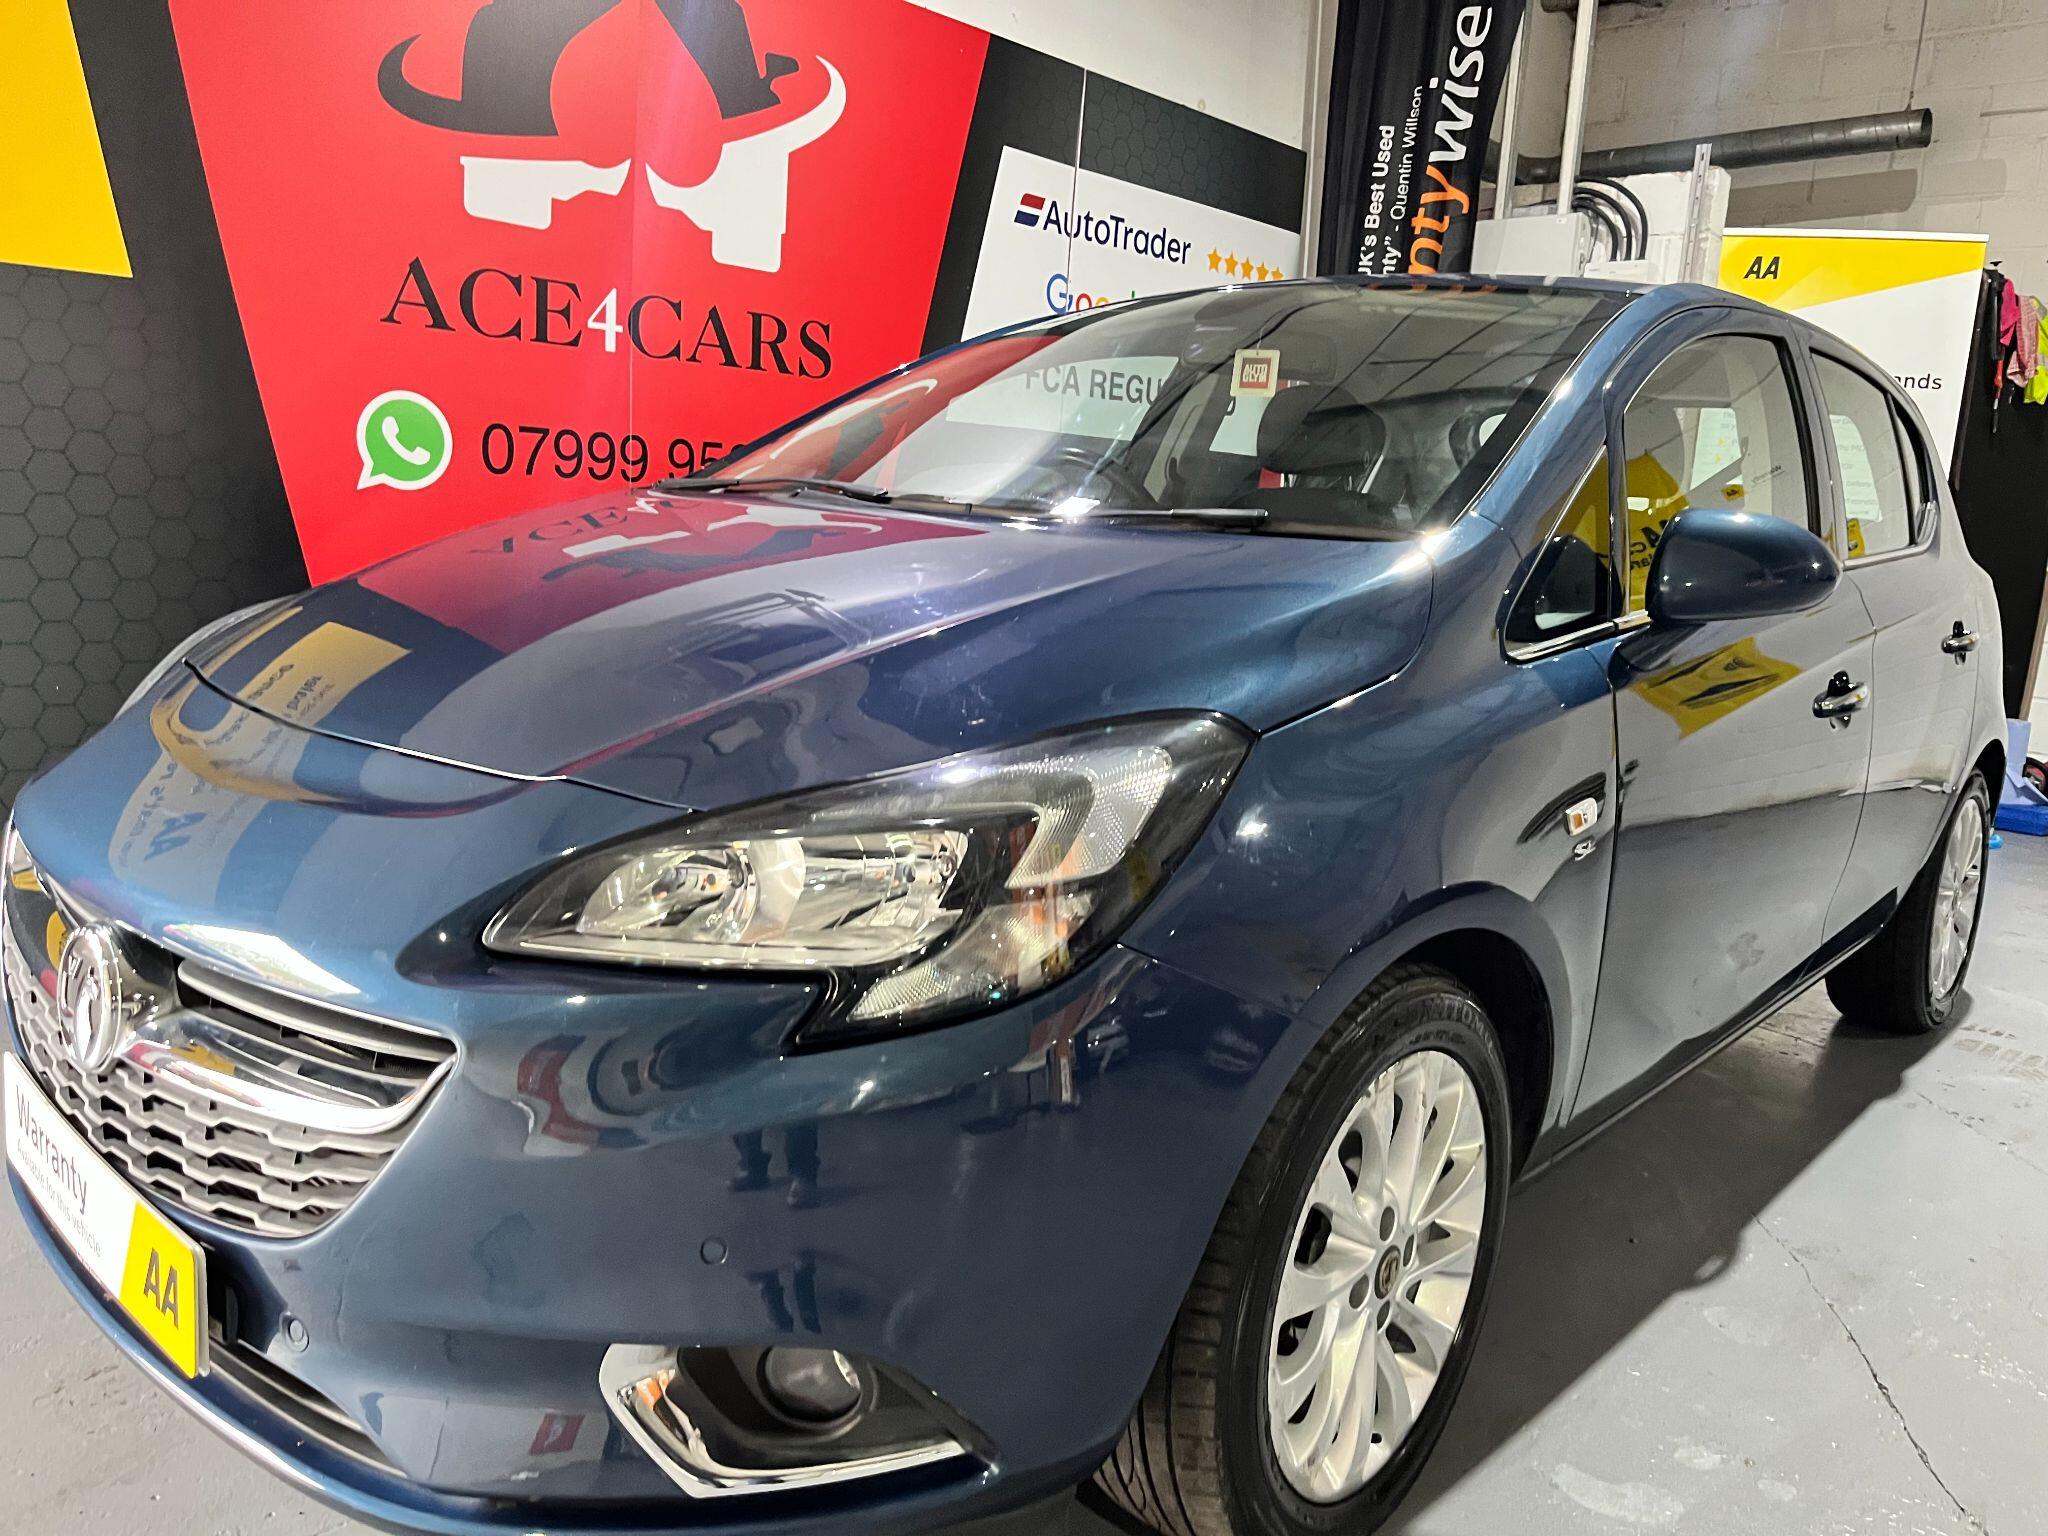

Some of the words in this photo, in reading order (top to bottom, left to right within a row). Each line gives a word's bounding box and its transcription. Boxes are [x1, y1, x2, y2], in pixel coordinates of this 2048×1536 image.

[1372, 125, 1395, 177] Used
[1390, 153, 1413, 219] Quentin
[1402, 85, 1423, 148] Willson
[1408, 5, 1493, 274] ntywise
[1042, 200, 1192, 265] AutoTrader
[1364, 182, 1386, 229] Best
[1743, 255, 1781, 280] AA
[380, 256, 833, 381] ACE4CARS
[1025, 365, 1081, 397] FCA
[1089, 369, 1163, 406] REGU
[481, 422, 649, 483] 07999
[667, 438, 745, 479] 95
[15, 1084, 88, 1215] Warranty
[72, 1213, 102, 1258] vehicle
[143, 1246, 179, 1330] AA
